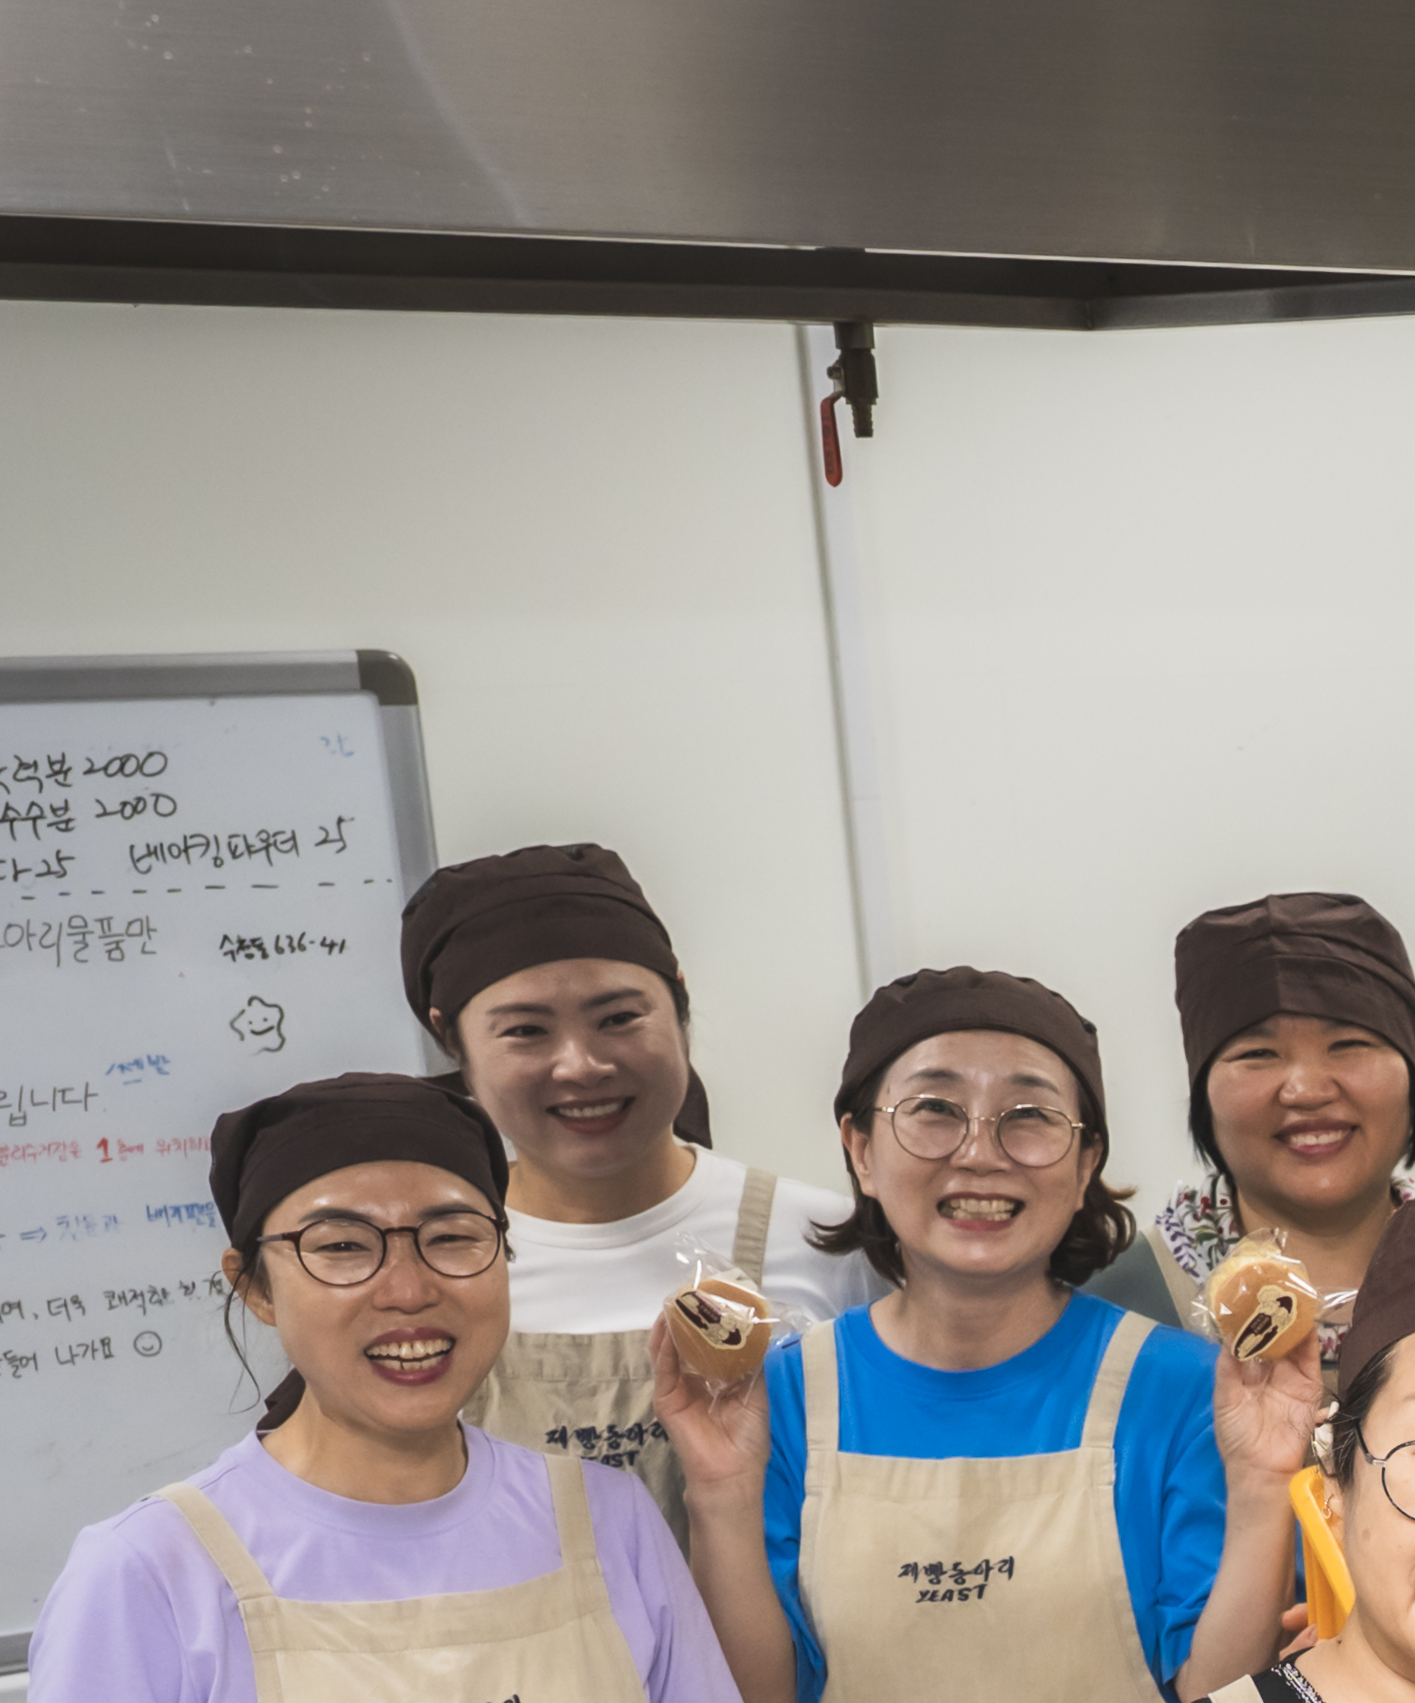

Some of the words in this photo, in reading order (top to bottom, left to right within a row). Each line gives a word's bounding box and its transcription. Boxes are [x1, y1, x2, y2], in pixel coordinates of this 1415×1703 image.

[83, 751, 168, 778] 2000
[95, 793, 177, 820] 2000
[315, 815, 355, 854] 25
[580, 1450, 640, 1467] AST
[898, 1555, 1015, 1586] 제빵동아리
[915, 1584, 988, 1603] YEAST
